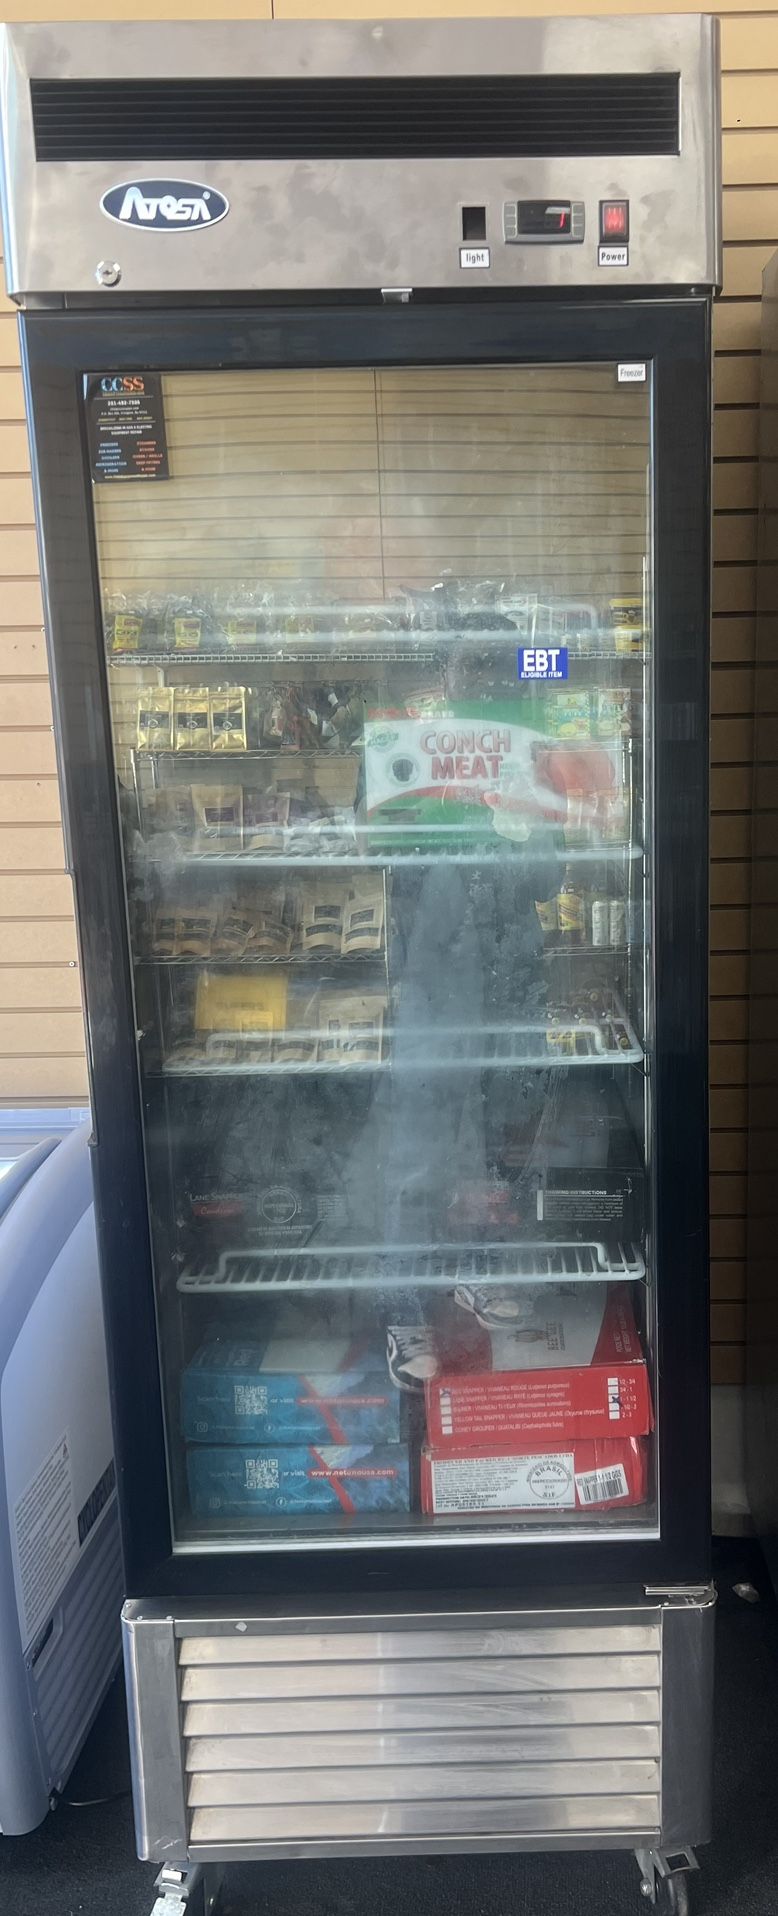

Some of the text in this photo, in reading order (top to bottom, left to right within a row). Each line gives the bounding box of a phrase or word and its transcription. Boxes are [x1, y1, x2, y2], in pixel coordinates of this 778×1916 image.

[466, 253, 484, 263] light
[601, 252, 625, 262] Power
[620, 368, 643, 377] Freezer
[100, 375, 144, 392] CCSS
[523, 649, 560, 672] EBT
[420, 729, 512, 755] CONCH
[431, 755, 504, 780] MEAT
[535, 1465, 562, 1476] BRASIL
